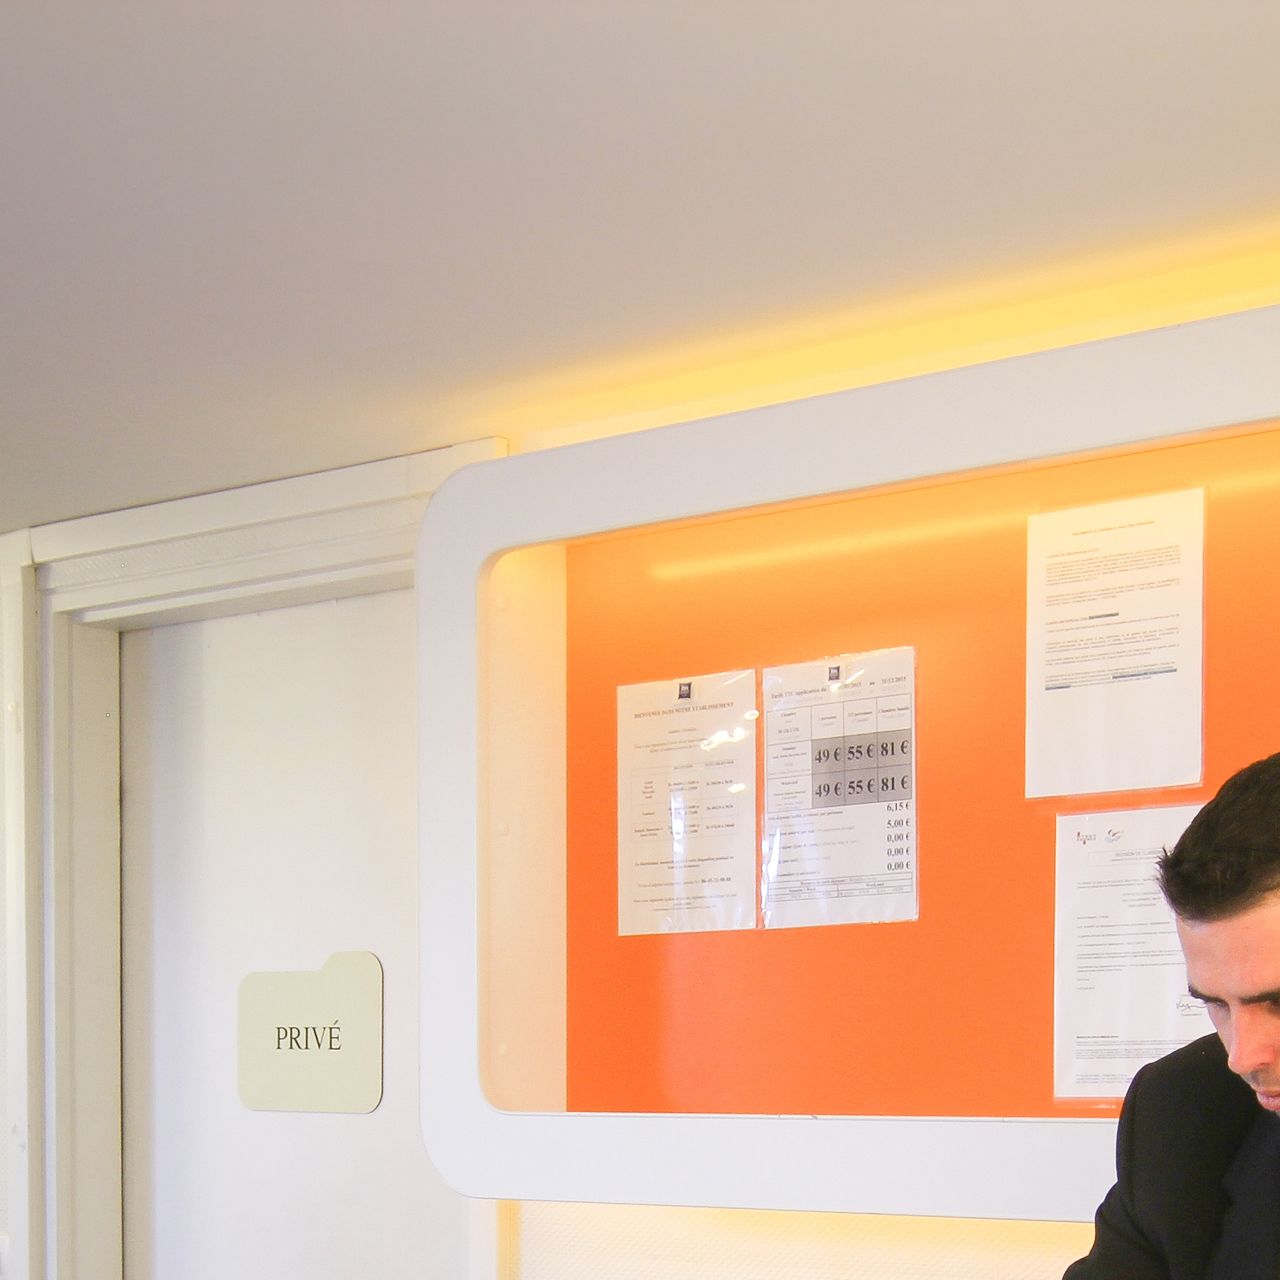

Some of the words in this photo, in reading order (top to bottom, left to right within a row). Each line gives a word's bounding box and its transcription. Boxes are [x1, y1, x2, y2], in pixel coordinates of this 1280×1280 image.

[815, 748, 830, 763] 49
[833, 747, 842, 762] €
[847, 745, 863, 761] 55
[867, 743, 875, 759] €
[880, 742, 895, 757] 81
[900, 740, 909, 755] €
[815, 783, 830, 798] 49
[834, 782, 842, 797] €
[847, 780, 864, 795] 55
[867, 778, 875, 793] €
[880, 776, 895, 792] 81
[901, 775, 909, 790] €
[886, 802, 904, 813] 6,15
[886, 819, 904, 829] 5,00
[886, 833, 904, 843] 0,00
[886, 848, 904, 858] 0,00
[886, 862, 904, 872] 0,00
[276, 1019, 342, 1051] PRIVÉ
